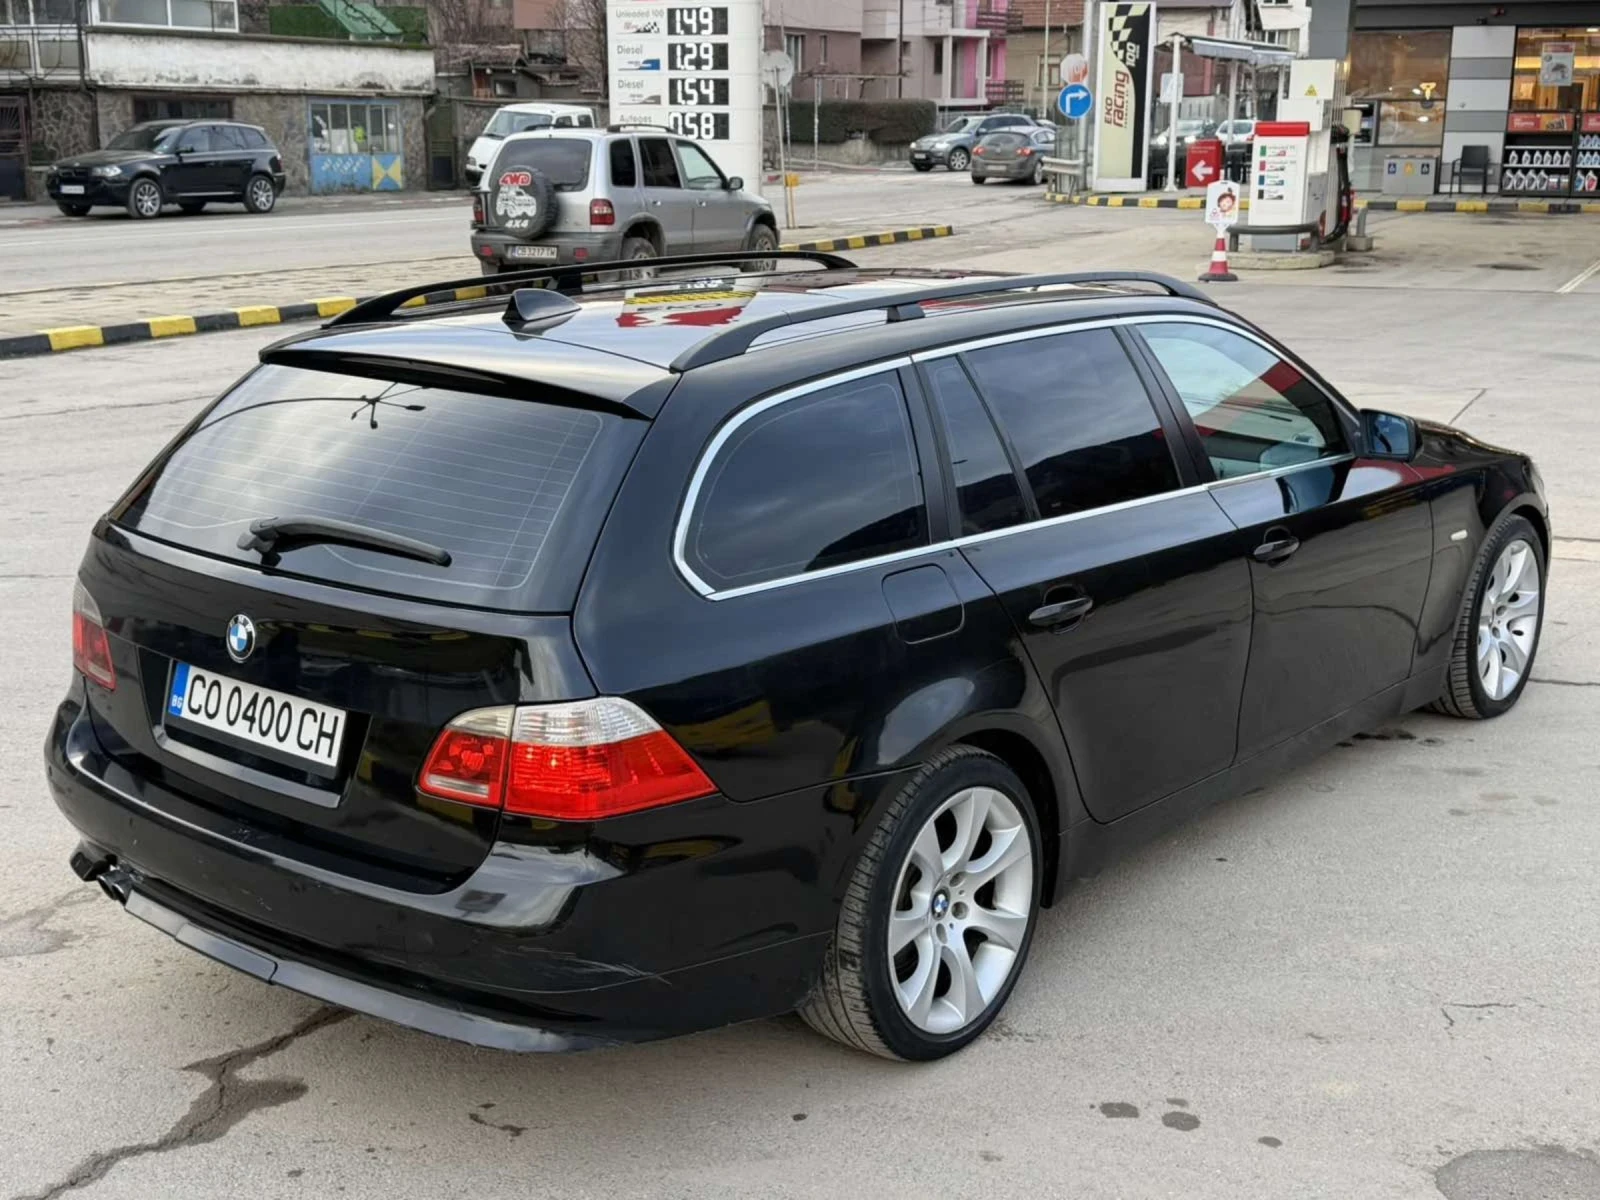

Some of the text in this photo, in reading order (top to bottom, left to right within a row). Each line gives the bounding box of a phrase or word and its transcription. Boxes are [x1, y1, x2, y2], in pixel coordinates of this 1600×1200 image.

[617, 45, 644, 55] Diesel
[1125, 41, 1136, 68] 100
[618, 79, 645, 89] Diesel
[1104, 96, 1113, 125] EKO
[1112, 70, 1130, 128] racing
[500, 172, 531, 186] 4WD
[187, 674, 339, 759] CO 0400 CH
